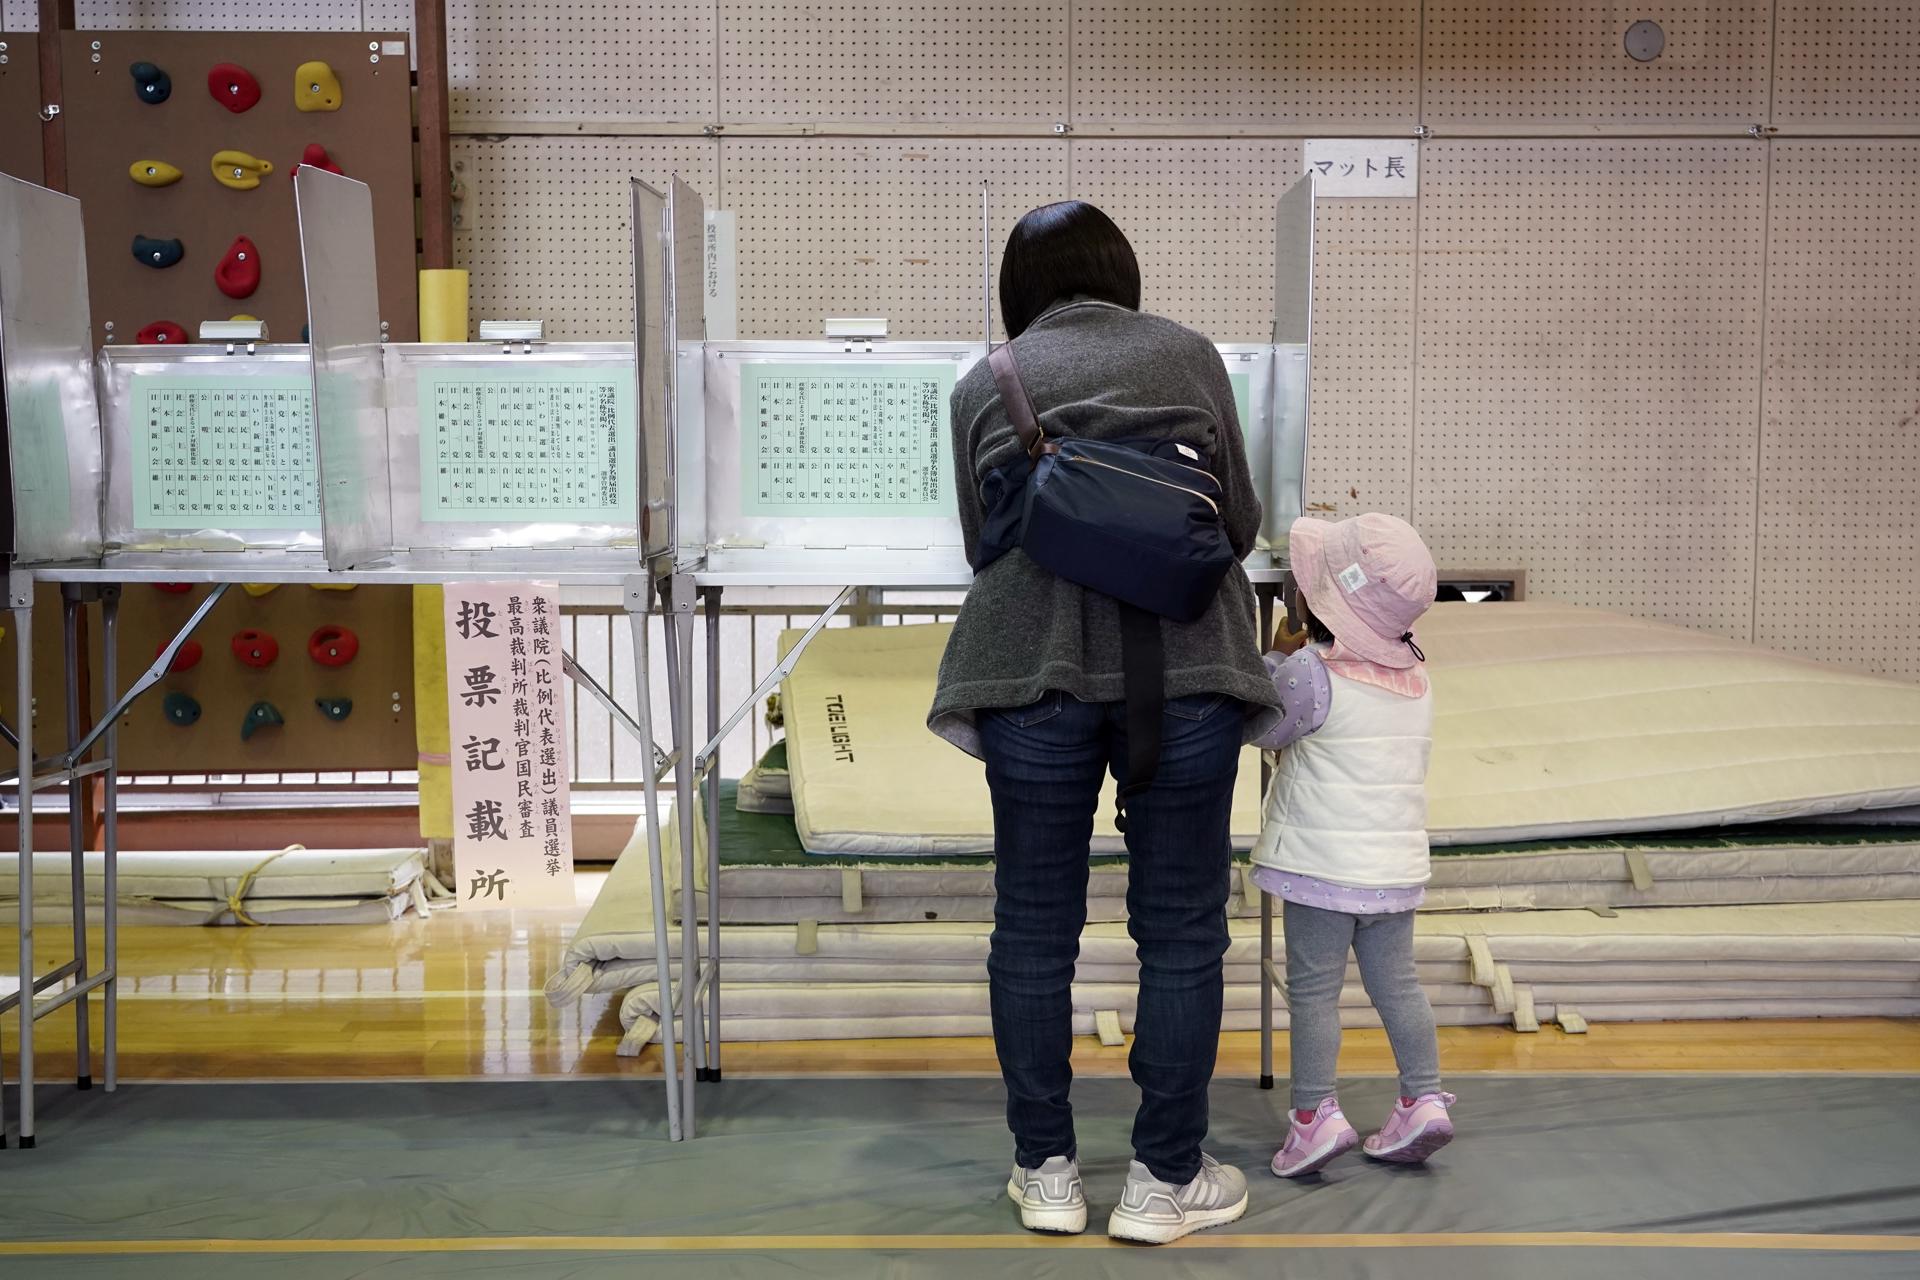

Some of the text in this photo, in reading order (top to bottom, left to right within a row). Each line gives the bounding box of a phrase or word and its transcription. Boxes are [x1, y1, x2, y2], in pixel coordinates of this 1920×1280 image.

[1313, 156, 1406, 179] マット長
[706, 223, 718, 298] 投票所内における
[151, 394, 159, 466] 日本維新の会
[163, 394, 172, 466] 日本第一党
[176, 394, 184, 466] 社会民主党
[201, 394, 209, 466] 公明党
[213, 394, 222, 466] 自由民主党
[226, 394, 235, 466] 国民民主党
[240, 394, 248, 466] 立憲民主党
[252, 394, 261, 466] れいわ新選組
[278, 394, 286, 466] 新党やまと
[290, 394, 300, 466] 日本共産党
[437, 387, 447, 459] 日本維新の会
[450, 387, 460, 459] 日本第一党
[462, 387, 472, 459] 社会民主党
[487, 387, 496, 459] 公明党
[500, 387, 509, 459] 自由民主党
[512, 387, 522, 459] 国民民主党
[525, 387, 534, 459] 立憲民主党
[538, 387, 547, 459] れいわ新選組
[563, 387, 571, 459] 新党やまと
[576, 387, 584, 459] 日本共産党
[599, 387, 608, 428] 等の名称等掲示
[810, 382, 818, 454] 公明党
[823, 382, 831, 454] 自由民主党
[836, 382, 844, 454] 国民民主党
[886, 382, 894, 454] 新党やまと
[922, 382, 930, 424] 等の名称等掲示
[152, 474, 160, 511] 維新
[190, 474, 198, 511] 新党
[202, 474, 211, 511] 公明
[215, 474, 224, 511] 自民党
[228, 474, 237, 511] 民主党
[241, 474, 250, 511] 民主党
[255, 474, 263, 511] れいわ
[267, 474, 275, 511] NHK党
[280, 474, 288, 511] やまと
[293, 474, 301, 511] 共産党
[440, 467, 448, 504] 維新
[465, 467, 473, 504] 社民党
[477, 467, 485, 504] 新党
[489, 467, 498, 504] 公明
[502, 467, 510, 504] 自民党
[515, 467, 523, 504] 民主党
[527, 467, 535, 504] 民主党
[540, 467, 548, 504] れいわ
[565, 467, 573, 504] やまと
[761, 462, 768, 499] 維新
[798, 462, 806, 499] 新党
[811, 462, 818, 499] 公明
[836, 462, 844, 499] 民主党
[849, 462, 857, 499] 民主党
[455, 600, 511, 901] 投票記載所
[507, 596, 535, 838] 最高裁判所裁判官国民審査
[531, 596, 560, 877] 衆議院（比例代表選出）議員選挙
[825, 694, 854, 763] TOEILIGHT
